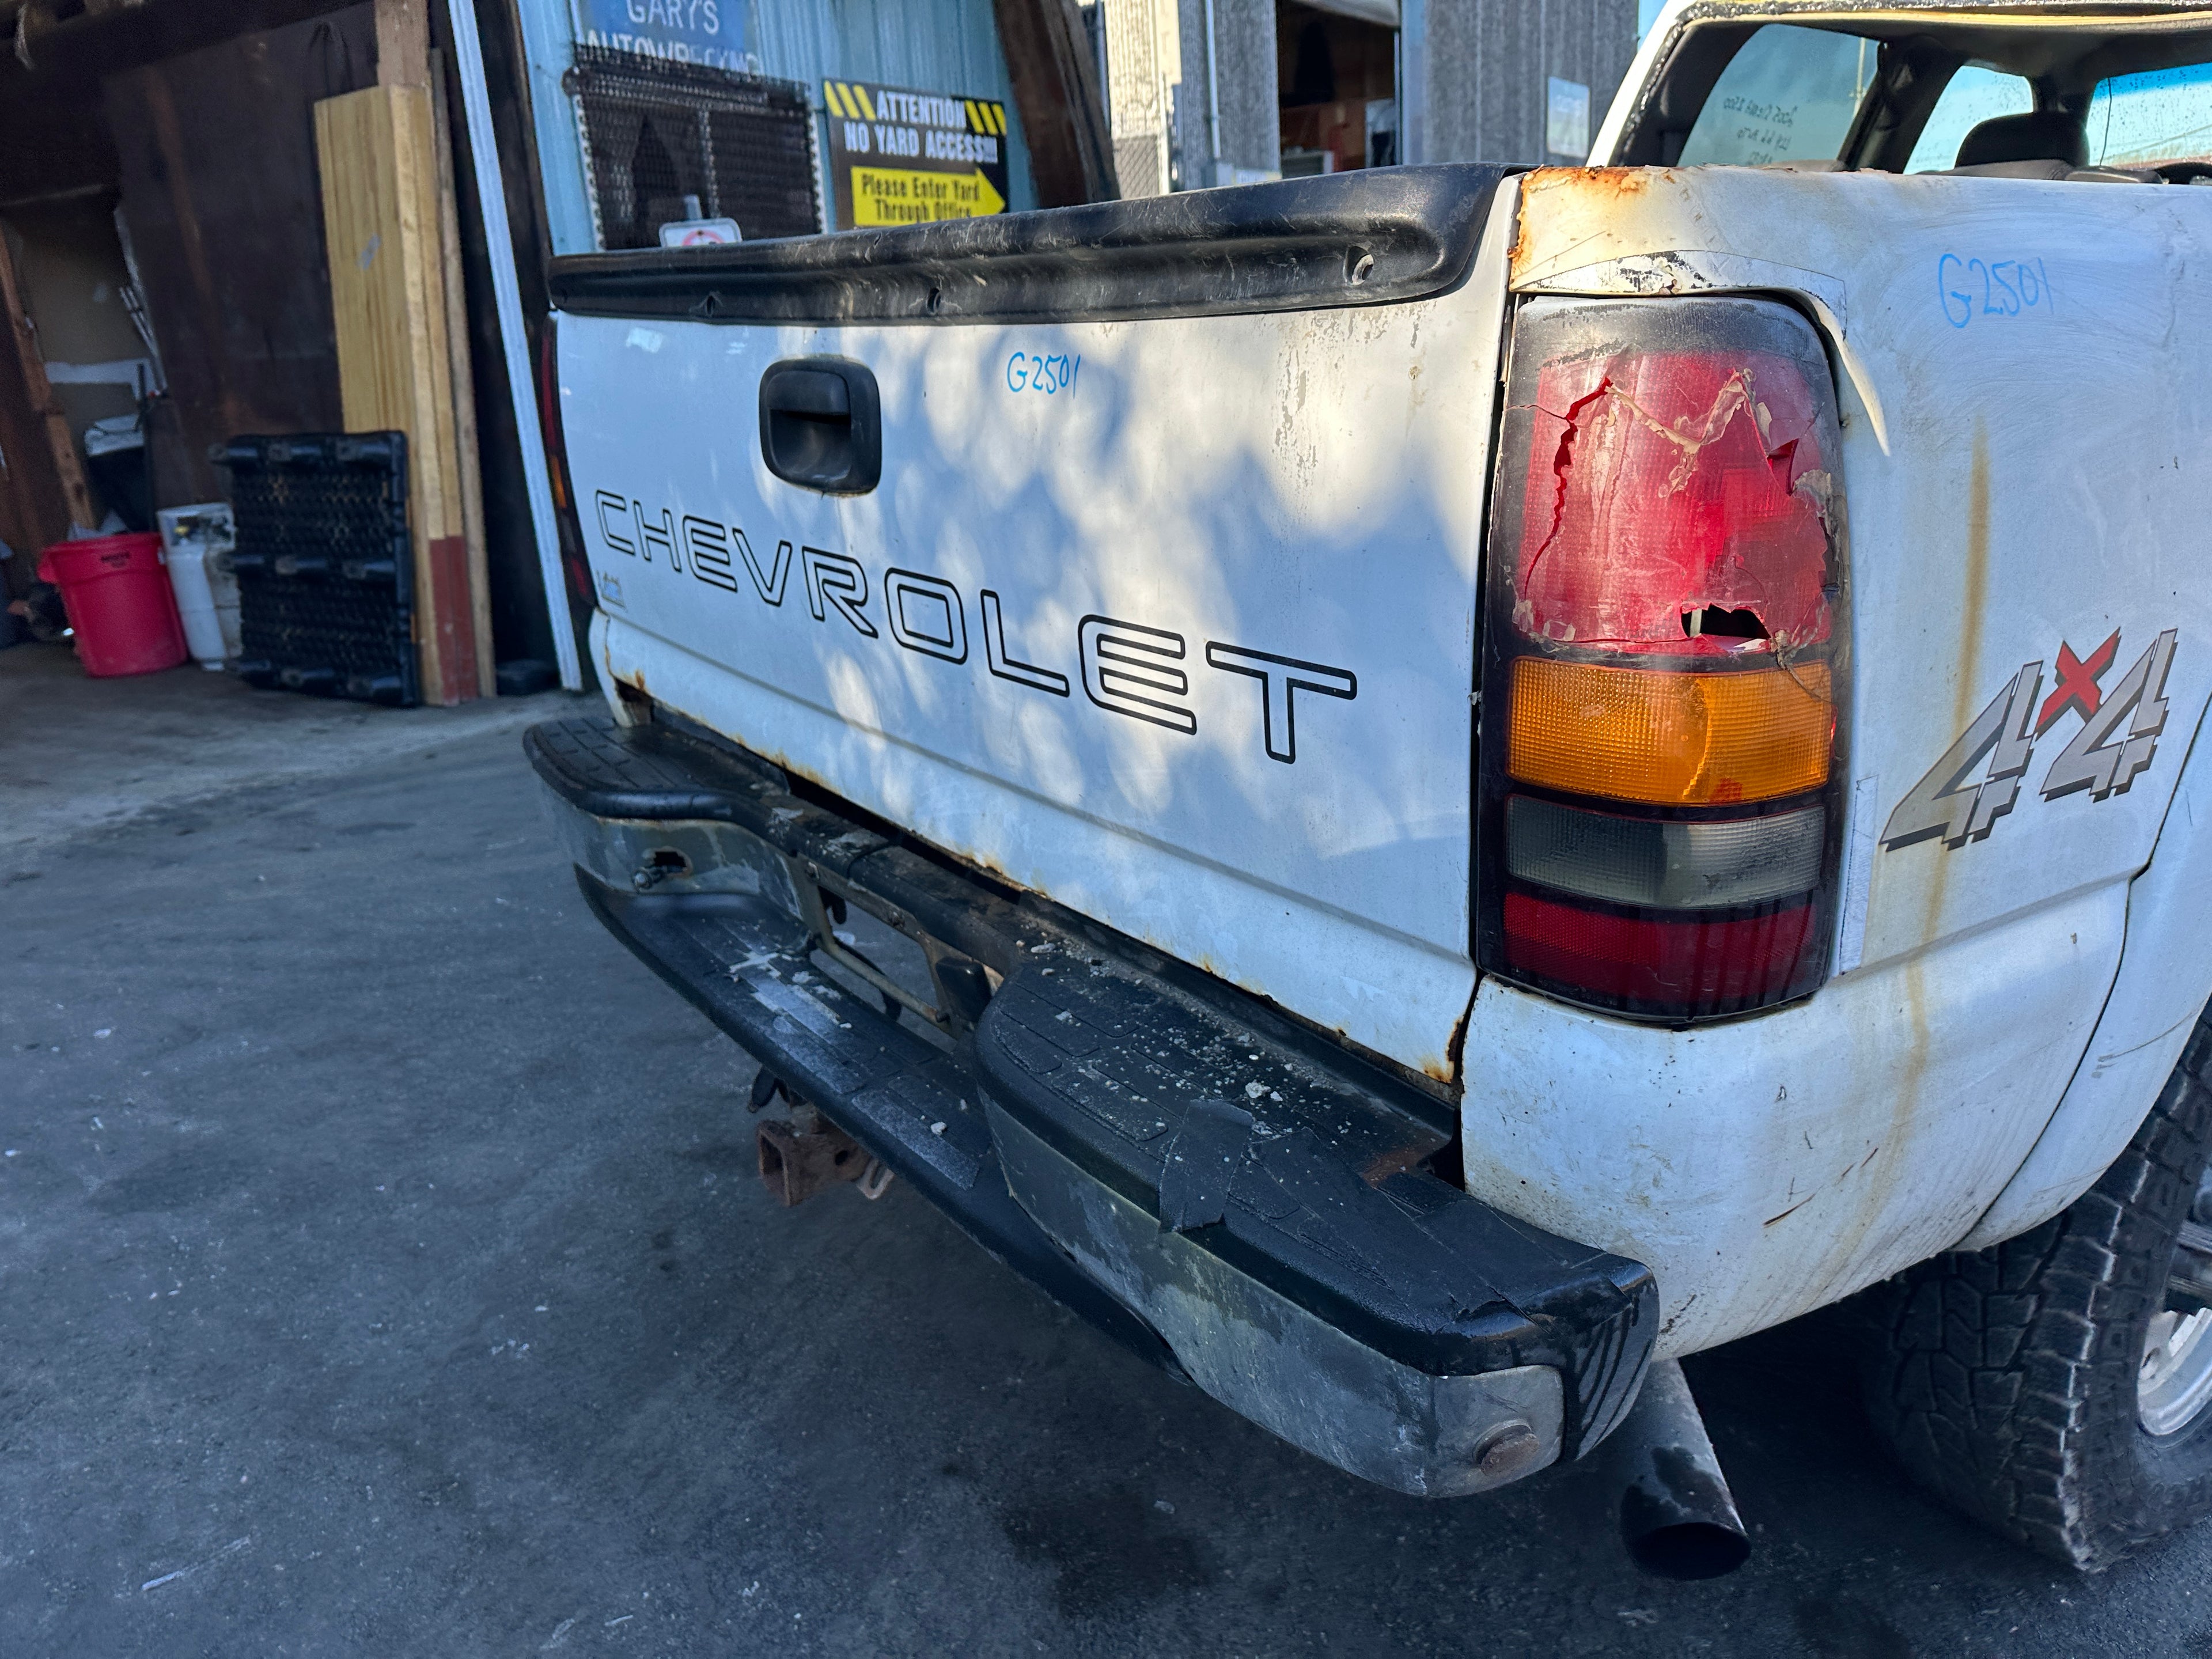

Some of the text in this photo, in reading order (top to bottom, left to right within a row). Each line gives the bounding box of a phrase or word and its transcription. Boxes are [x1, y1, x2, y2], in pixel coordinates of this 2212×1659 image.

[877, 90, 967, 130] ATTENTION
[844, 121, 870, 154] NO
[874, 124, 920, 157] YARD
[862, 173, 980, 202] Please Enter Yard
[874, 198, 972, 224] Through Office
[1938, 253, 2055, 329] G2501
[1007, 351, 1081, 399] G2501
[594, 488, 1357, 764] CHEVROLET
